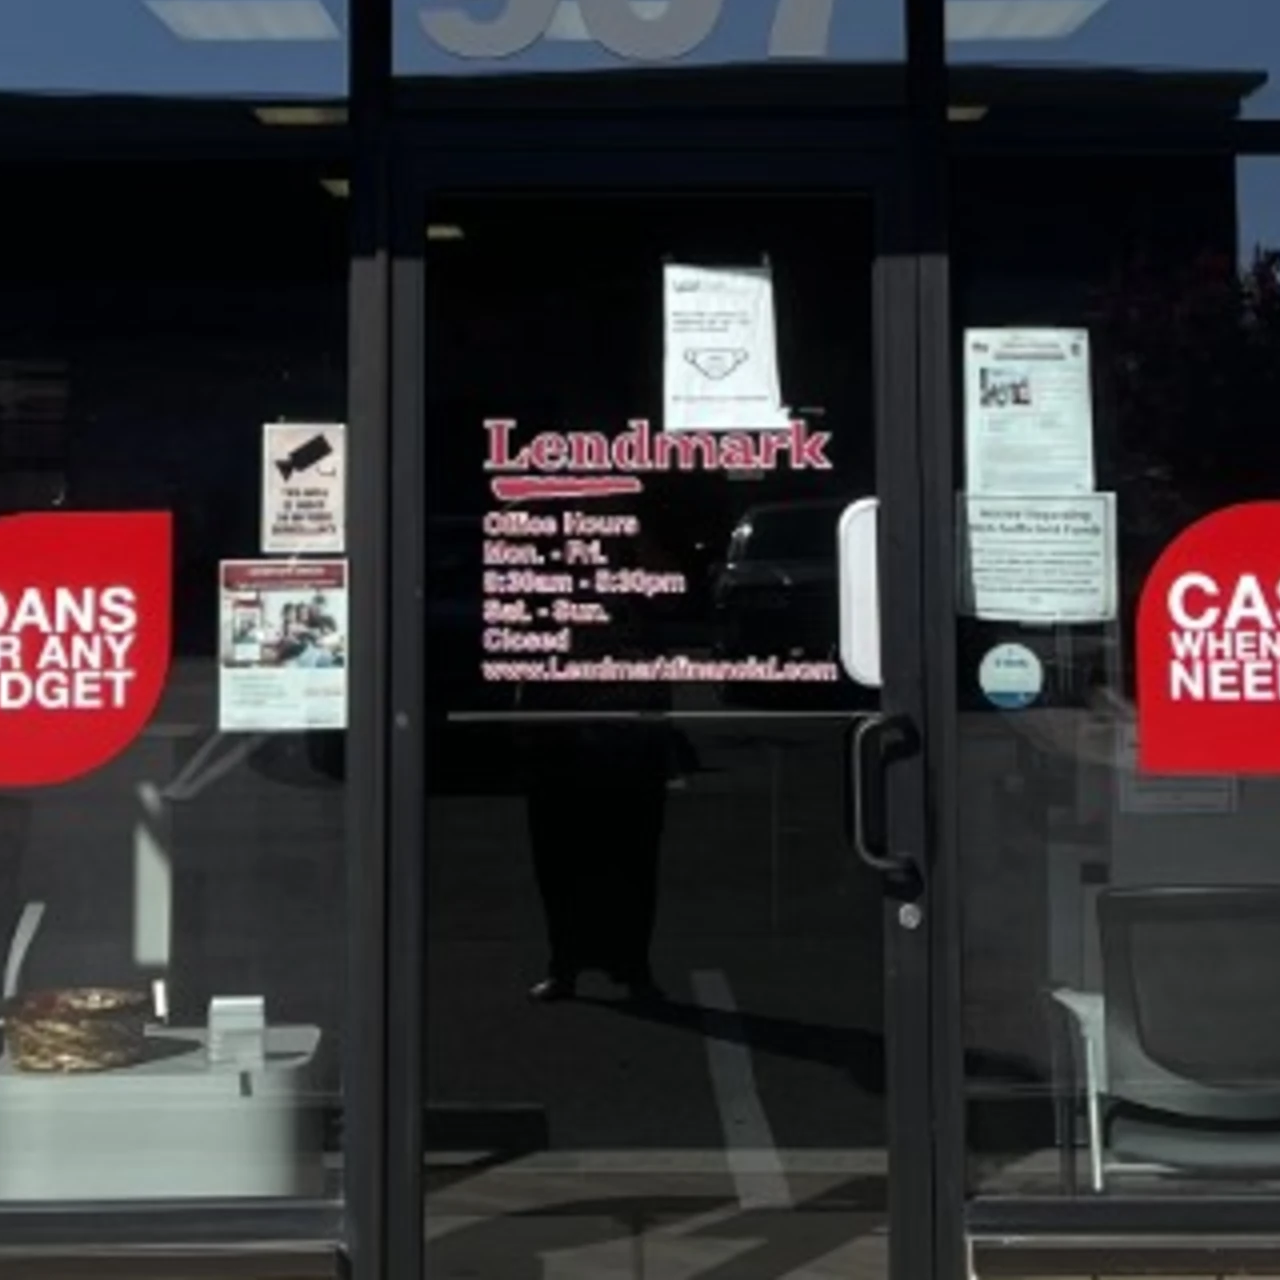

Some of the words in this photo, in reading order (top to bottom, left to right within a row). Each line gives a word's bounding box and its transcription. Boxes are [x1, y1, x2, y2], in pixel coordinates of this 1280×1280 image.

[483, 419, 832, 470] Lendmark
[482, 511, 558, 536] Office
[563, 511, 640, 536] Hours
[482, 541, 546, 565] Mon.
[565, 540, 609, 565] Fri.
[35, 634, 135, 670] ANY
[482, 628, 571, 653] Closed
